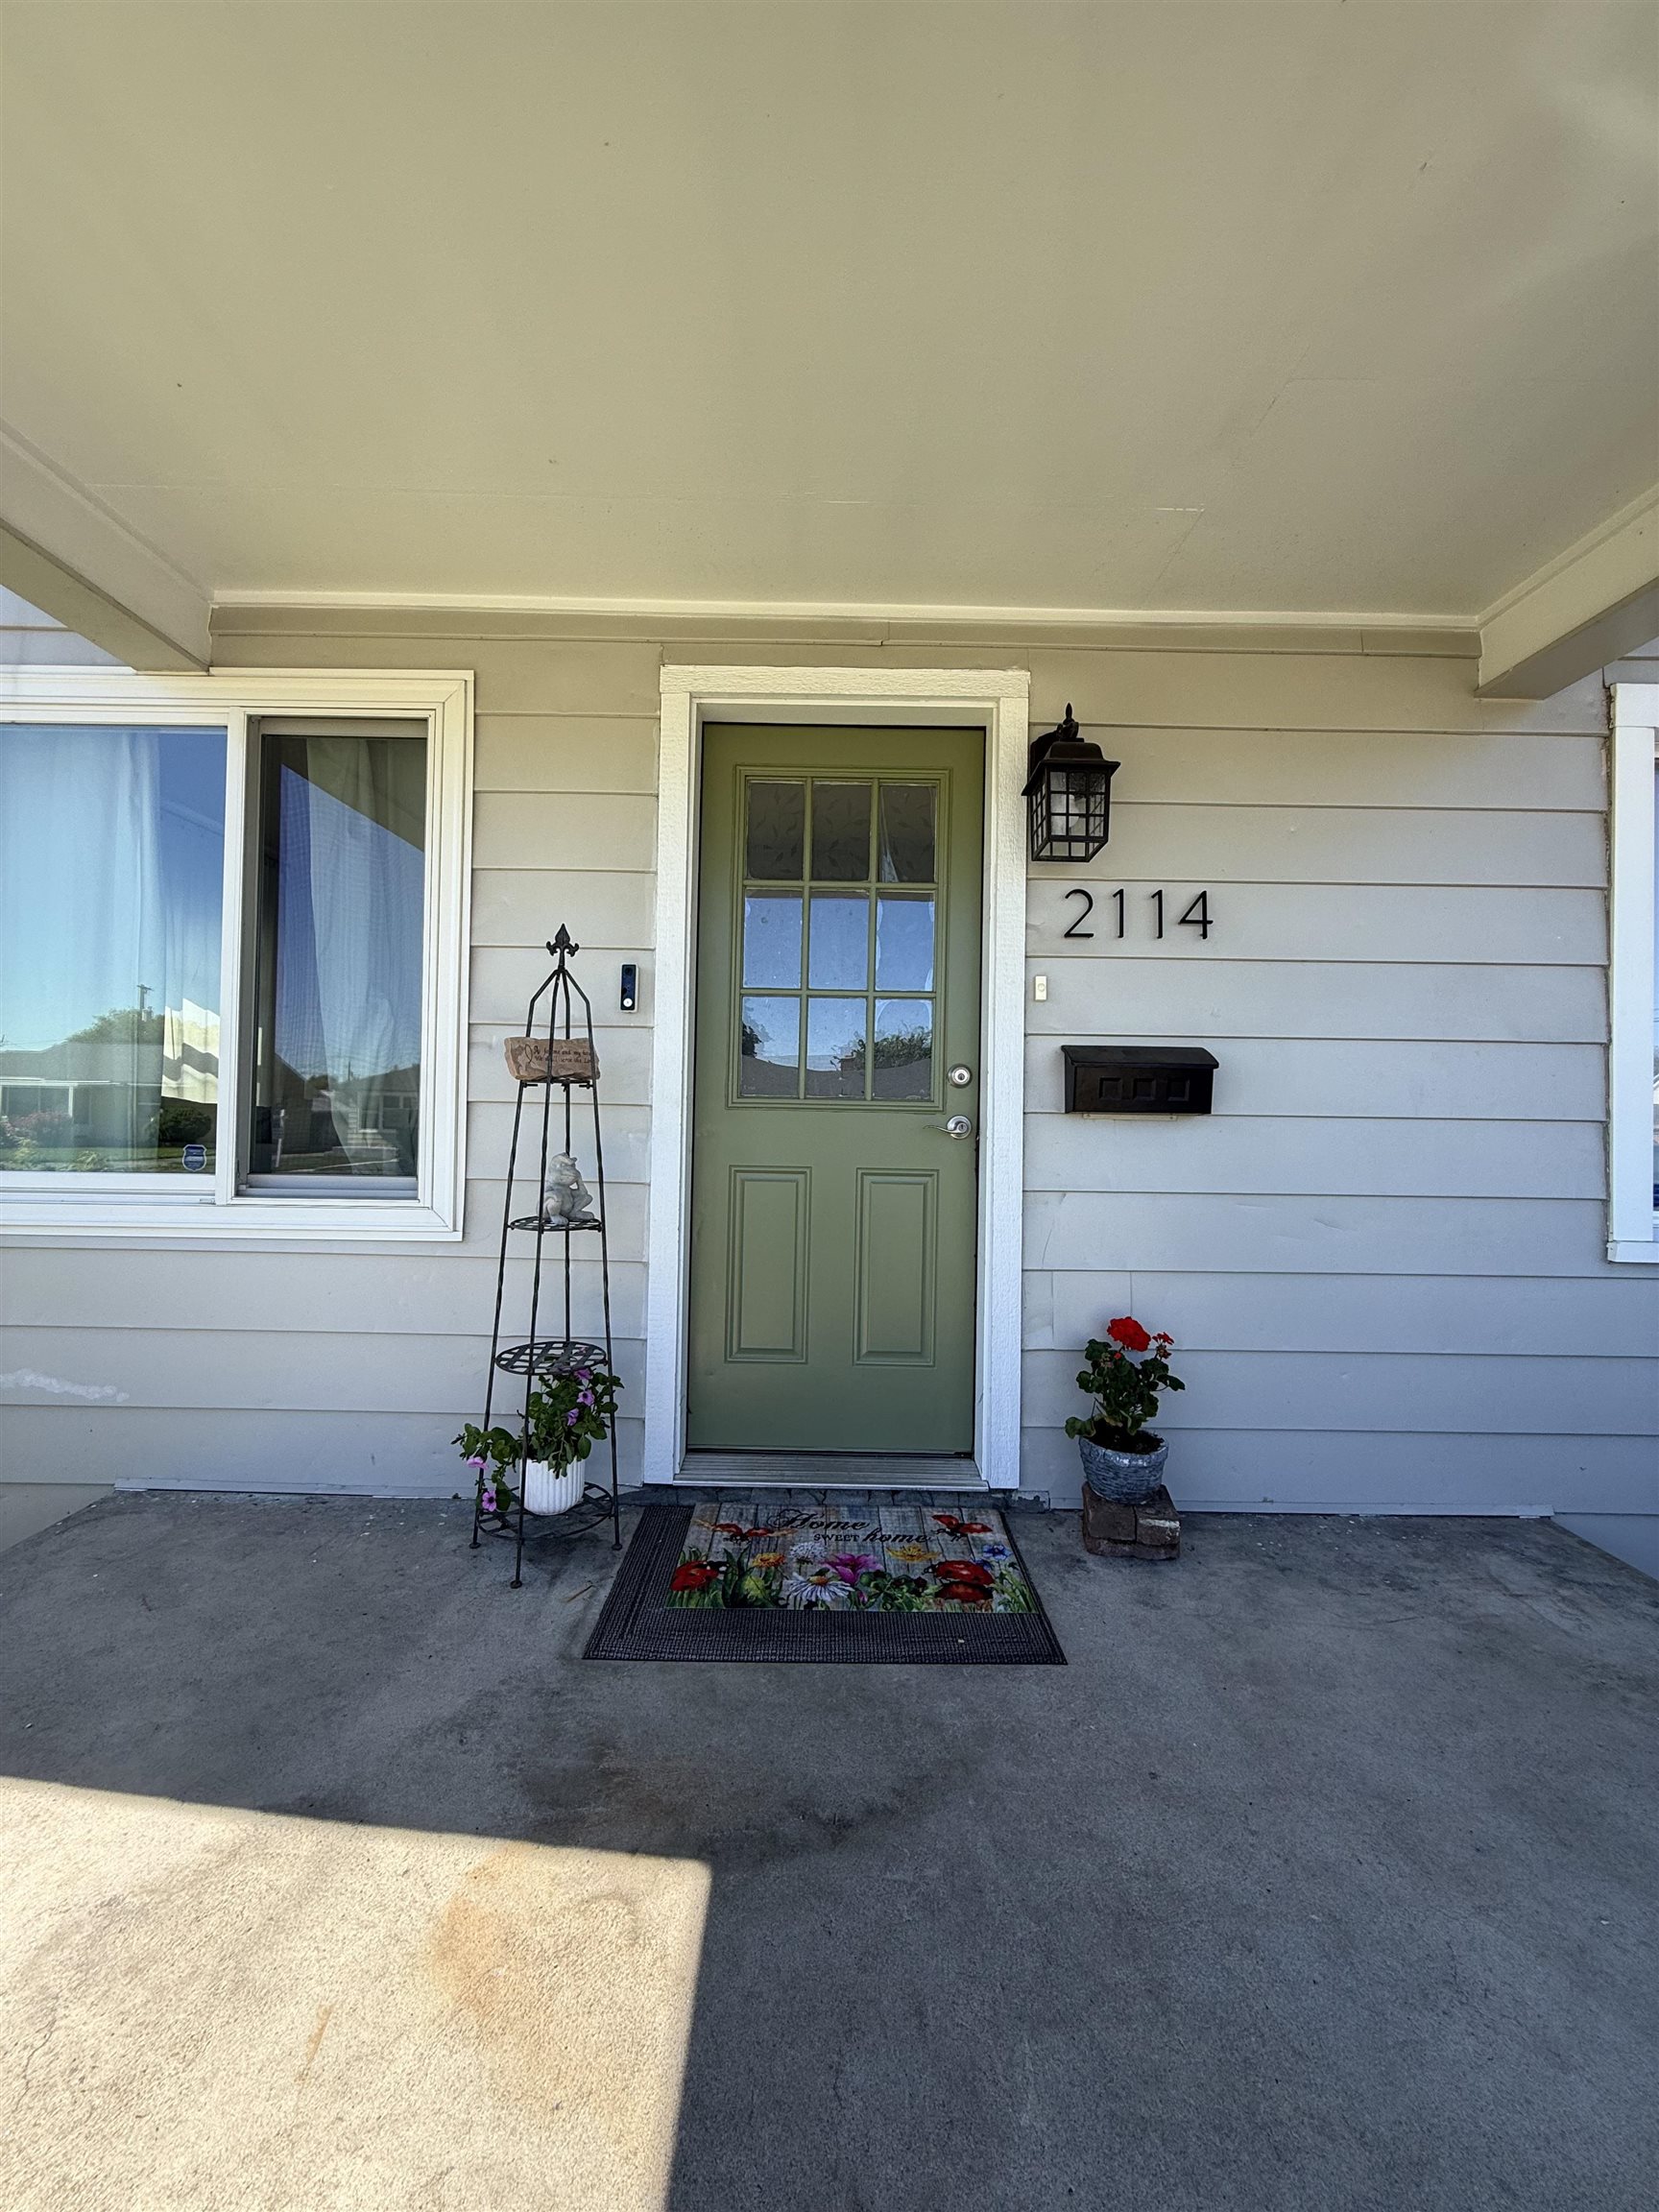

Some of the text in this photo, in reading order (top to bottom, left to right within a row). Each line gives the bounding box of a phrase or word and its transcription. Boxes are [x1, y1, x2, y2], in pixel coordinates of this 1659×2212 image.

[1064, 888, 1214, 940] 2114
[767, 1508, 870, 1530] Home
[813, 1527, 932, 1543] SWEET home
